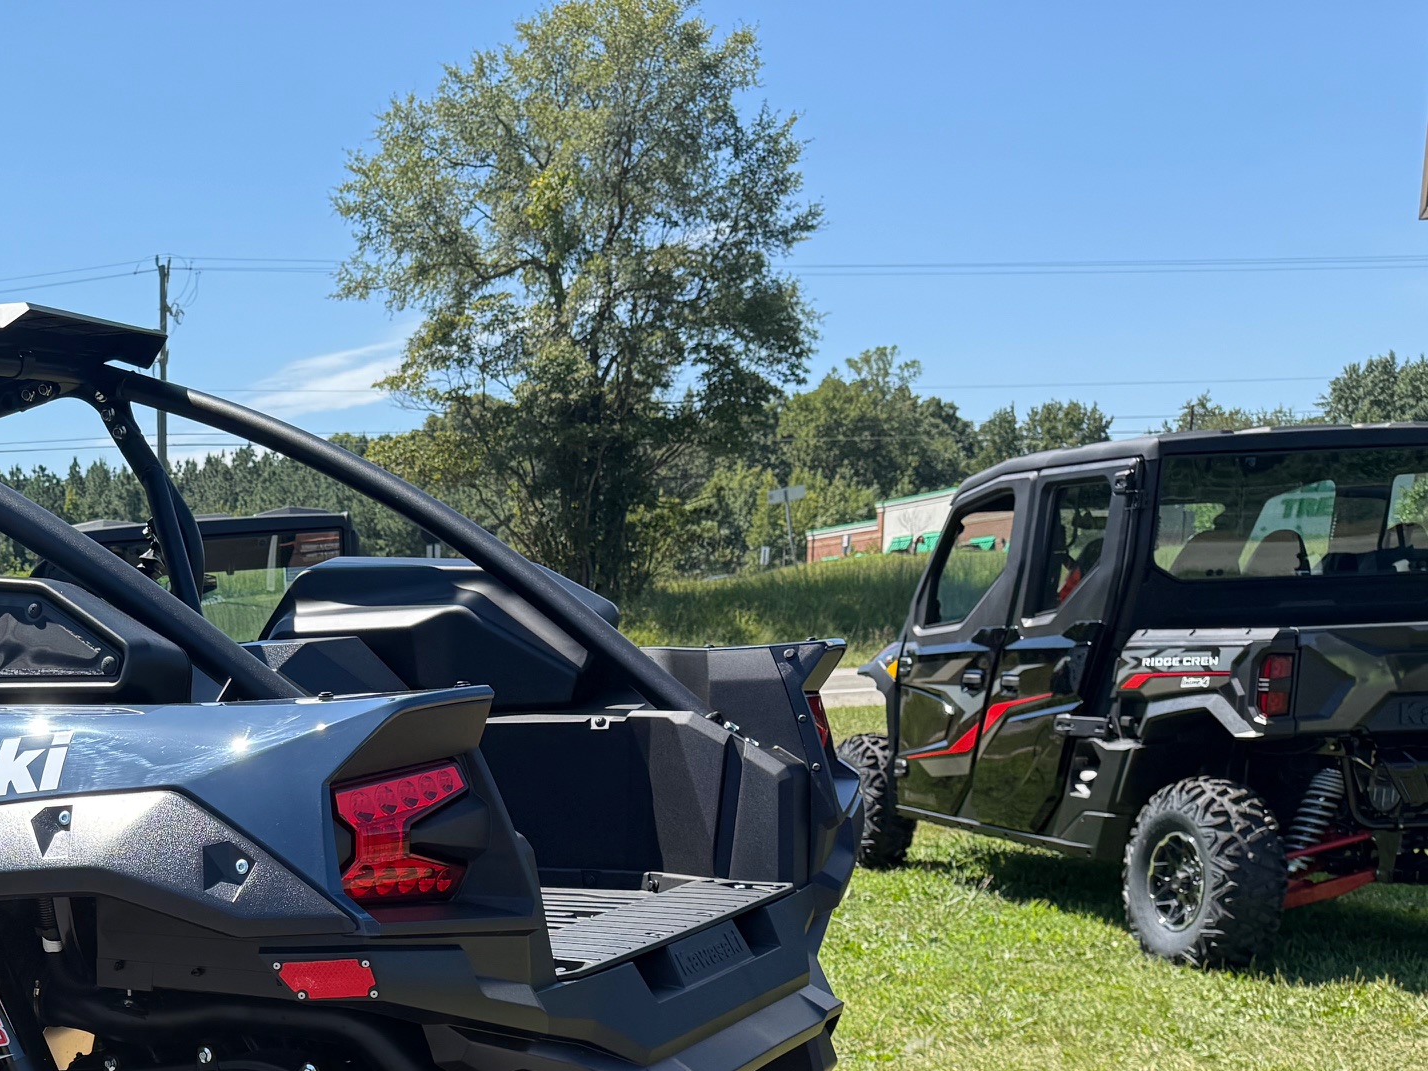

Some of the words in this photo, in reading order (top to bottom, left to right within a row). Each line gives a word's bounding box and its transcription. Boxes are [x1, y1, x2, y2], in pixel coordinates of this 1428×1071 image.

[1142, 656, 1180, 667] RIDGE
[1182, 656, 1219, 667] CREW
[675, 930, 743, 976] Kawasaki
